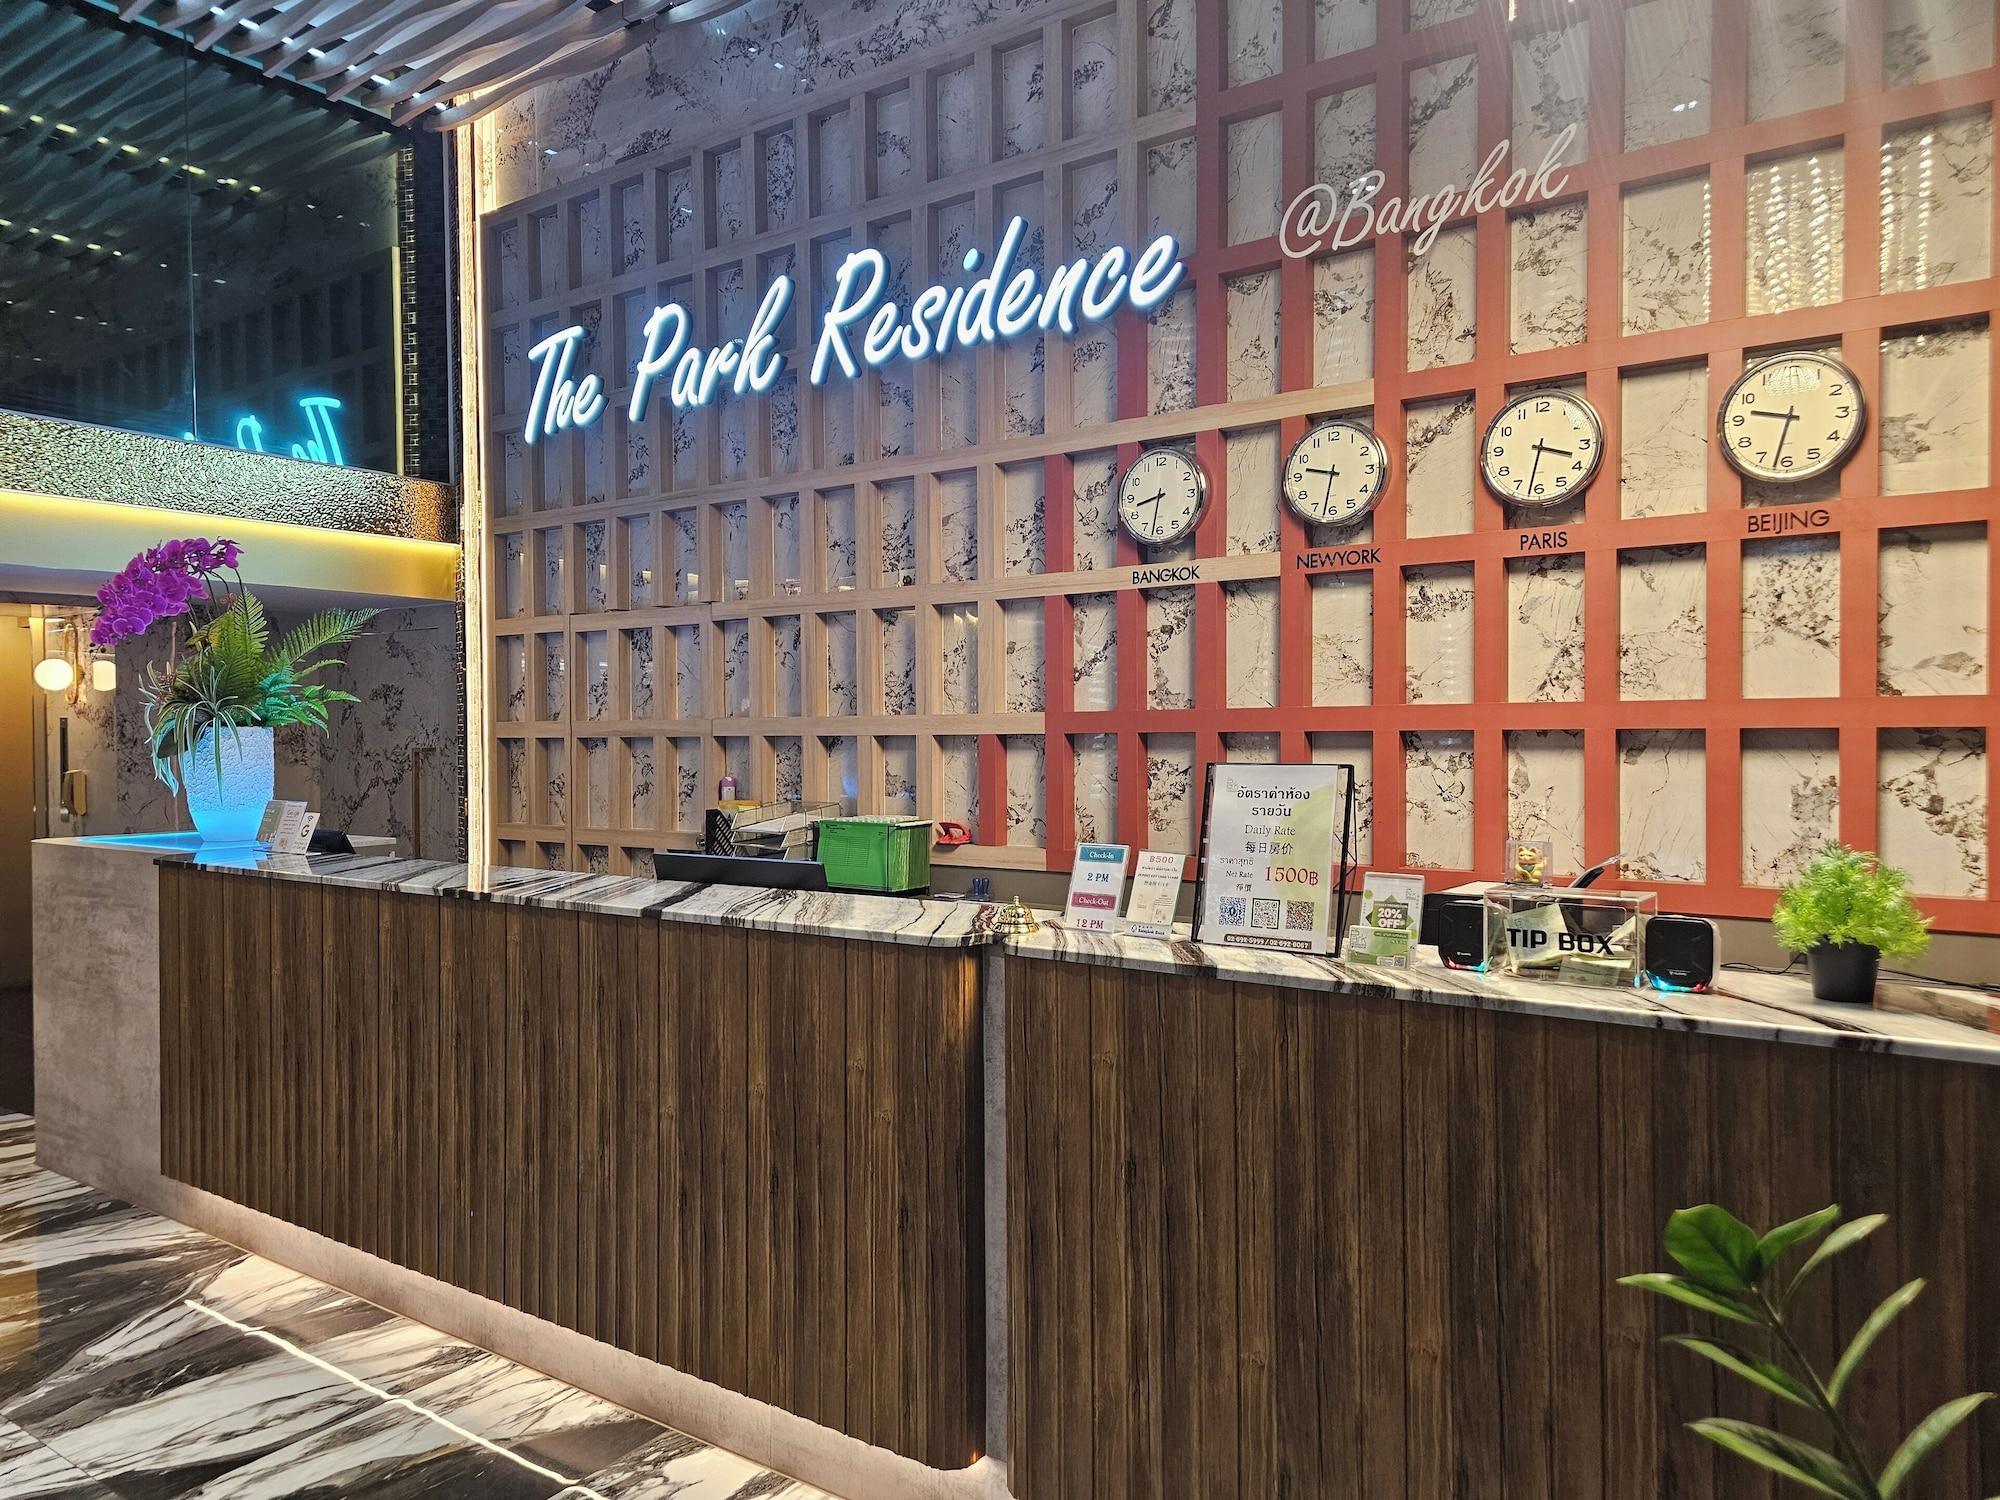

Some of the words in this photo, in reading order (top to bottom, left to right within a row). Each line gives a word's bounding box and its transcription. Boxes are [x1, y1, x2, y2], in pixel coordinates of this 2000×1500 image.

[1279, 122, 1578, 258] @Bangkok
[524, 325, 604, 446] The
[628, 275, 796, 422] Park
[811, 215, 1186, 386] Residence
[1829, 384, 1843, 396] 2
[1742, 393, 1755, 405] 10
[1536, 402, 1550, 413] 12
[1835, 406, 1850, 418] 3
[1518, 409, 1526, 420] 11
[1732, 415, 1745, 427] 9
[1328, 431, 1340, 442] 12
[1501, 426, 1512, 437] 10
[1826, 430, 1840, 442] 4
[1313, 438, 1320, 448] 11
[1579, 439, 1591, 450] 3
[1738, 437, 1752, 448] 8
[1360, 446, 1369, 456] 2
[1493, 447, 1504, 456] 9
[1806, 448, 1820, 460] 5
[1156, 457, 1167, 466] 12
[1300, 455, 1309, 464] 10
[1756, 452, 1767, 463] 7
[1780, 456, 1793, 467] 6
[1144, 463, 1150, 472] 11
[1365, 464, 1374, 474] 3
[1572, 460, 1583, 471] 4
[1498, 466, 1510, 476] 8
[1183, 472, 1191, 481] 2
[1293, 473, 1302, 482] 9
[1132, 478, 1141, 486] 10
[1513, 479, 1523, 490] 7
[1555, 477, 1567, 487] 5
[1187, 488, 1196, 498] 3
[1360, 484, 1369, 493] 4
[1534, 484, 1545, 494] 6
[1127, 494, 1134, 503] 9
[1298, 491, 1308, 499] 8
[1311, 503, 1319, 512] 7
[1346, 499, 1356, 508] 5
[1130, 511, 1139, 520] 8
[1182, 507, 1190, 515] 4
[1328, 506, 1338, 515] 6
[1171, 521, 1179, 529] 5
[1748, 509, 1830, 532] BEIJING
[1142, 523, 1148, 531] 7
[1156, 526, 1164, 535] 6
[1520, 532, 1569, 550] PARIS
[1297, 548, 1381, 569] NEWYORK
[1132, 566, 1200, 584] BANGKOK
[1237, 786, 1310, 800] อัตราค่าห้อง
[1252, 804, 1291, 817] รายวัน
[1245, 825, 1271, 837] Daily
[1274, 826, 1296, 836] Rate
[1245, 841, 1293, 855] 每日房价
[1089, 851, 1114, 859] Check-In
[1087, 873, 1093, 881] 2
[1096, 873, 1109, 882] PM
[1078, 897, 1109, 906] Check-Out
[1378, 908, 1402, 918] 20%
[1076, 919, 1087, 928] 12
[1090, 920, 1104, 929] PM
[1507, 928, 1547, 948] TIP
[1559, 933, 1615, 955] BOX
